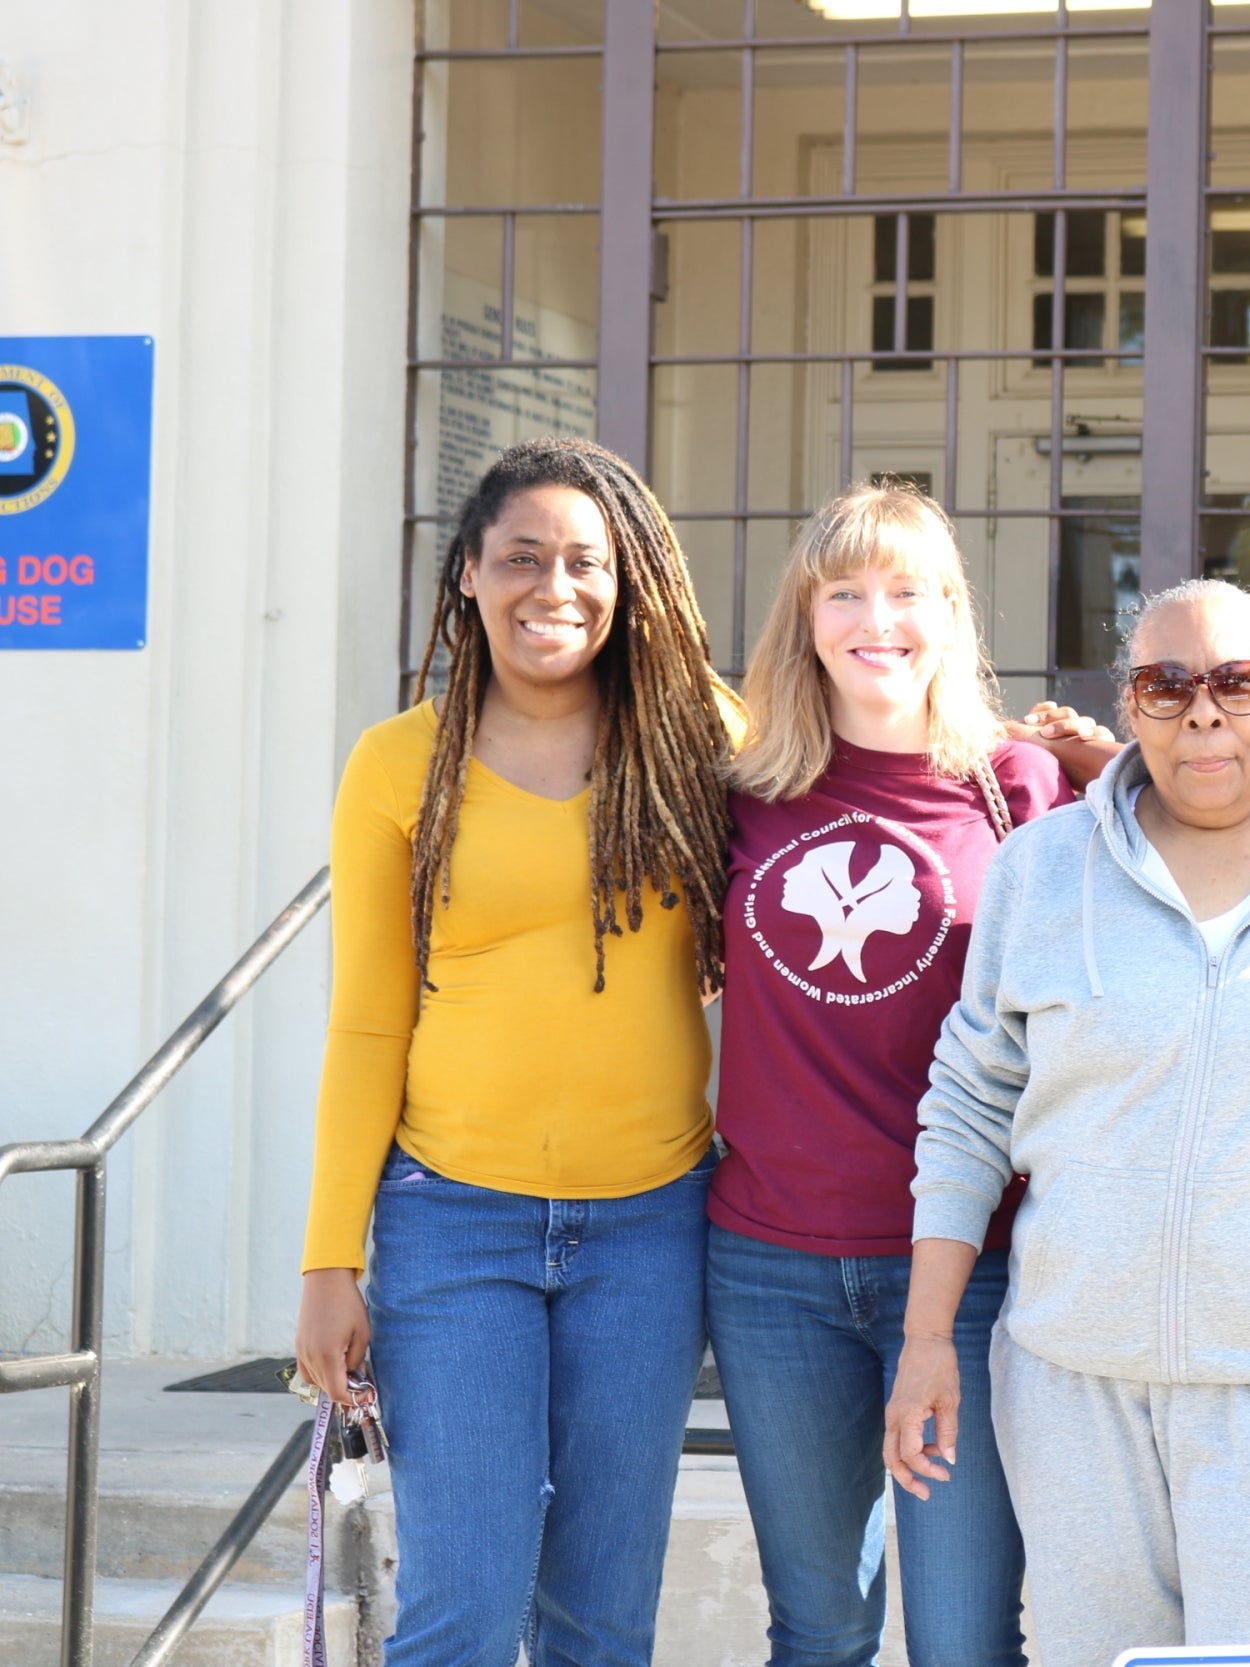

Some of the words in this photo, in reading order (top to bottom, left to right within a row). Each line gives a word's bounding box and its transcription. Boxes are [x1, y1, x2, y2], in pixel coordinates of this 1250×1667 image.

[18, 554, 95, 586] DOG
[800, 813, 852, 841] Council
[851, 811, 873, 823] for
[753, 839, 799, 882] National
[744, 893, 757, 930] Girls
[751, 931, 775, 959] and
[916, 908, 957, 972] Formerly
[773, 959, 822, 1001] Women
[826, 970, 919, 1007] Incarcerated
